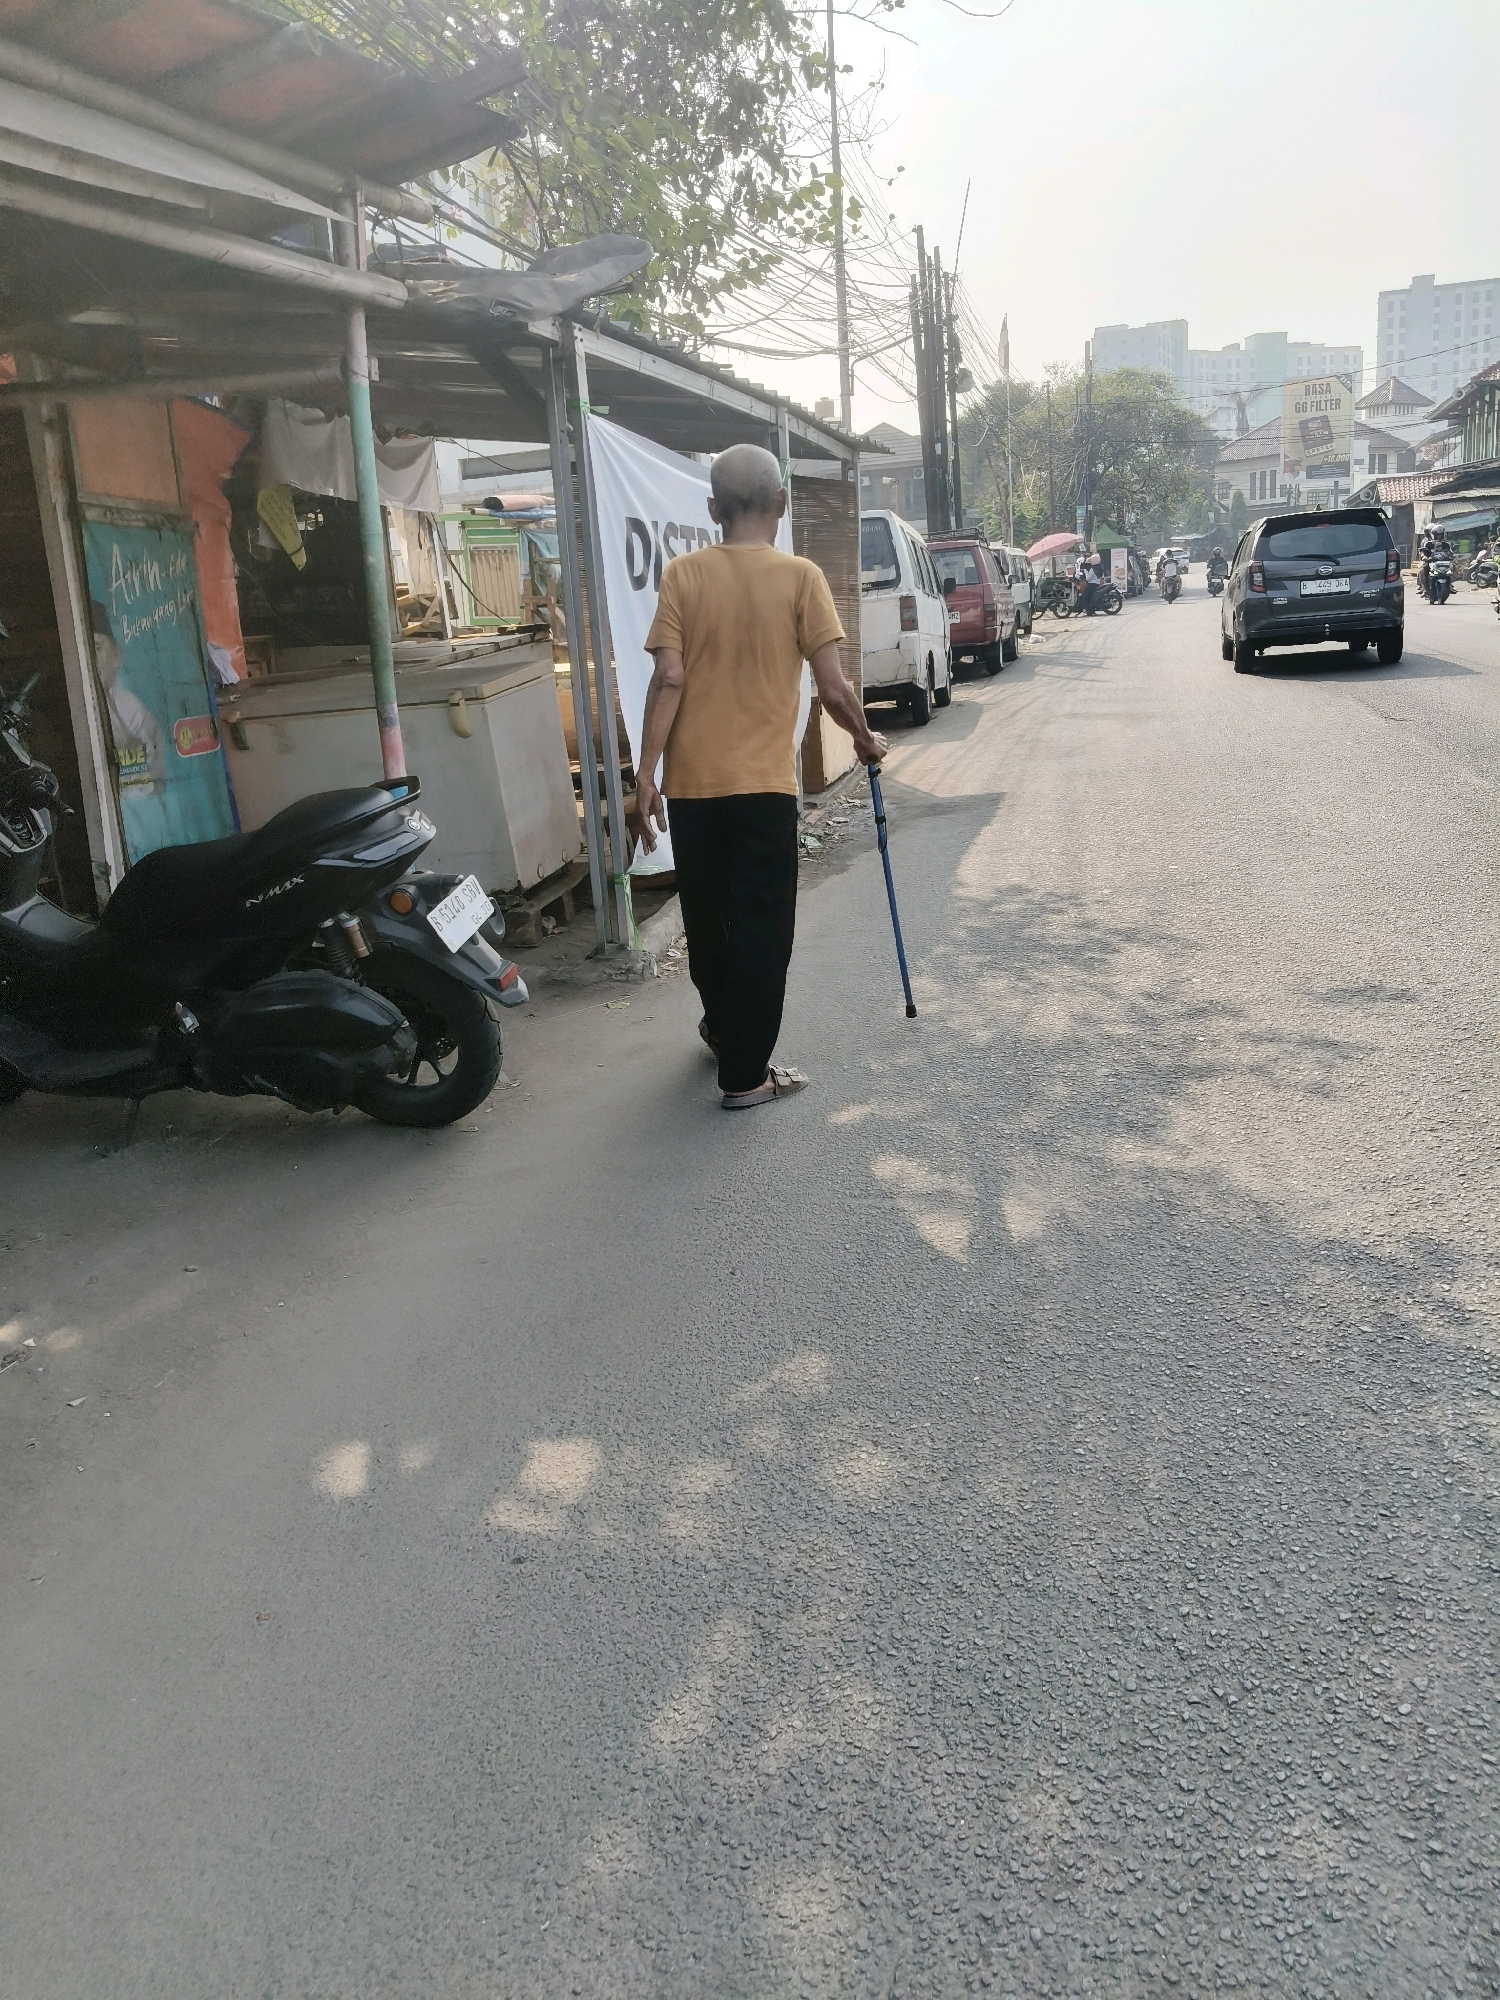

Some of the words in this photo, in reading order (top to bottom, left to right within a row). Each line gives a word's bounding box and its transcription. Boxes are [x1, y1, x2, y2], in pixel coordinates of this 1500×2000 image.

[1304, 382, 1332, 397] RASA
[1294, 401, 1308, 414] GG
[1310, 397, 1342, 413] FILTER
[624, 516, 723, 593] DIST
[245, 873, 305, 908] NMAX
[430, 915, 444, 932] B
